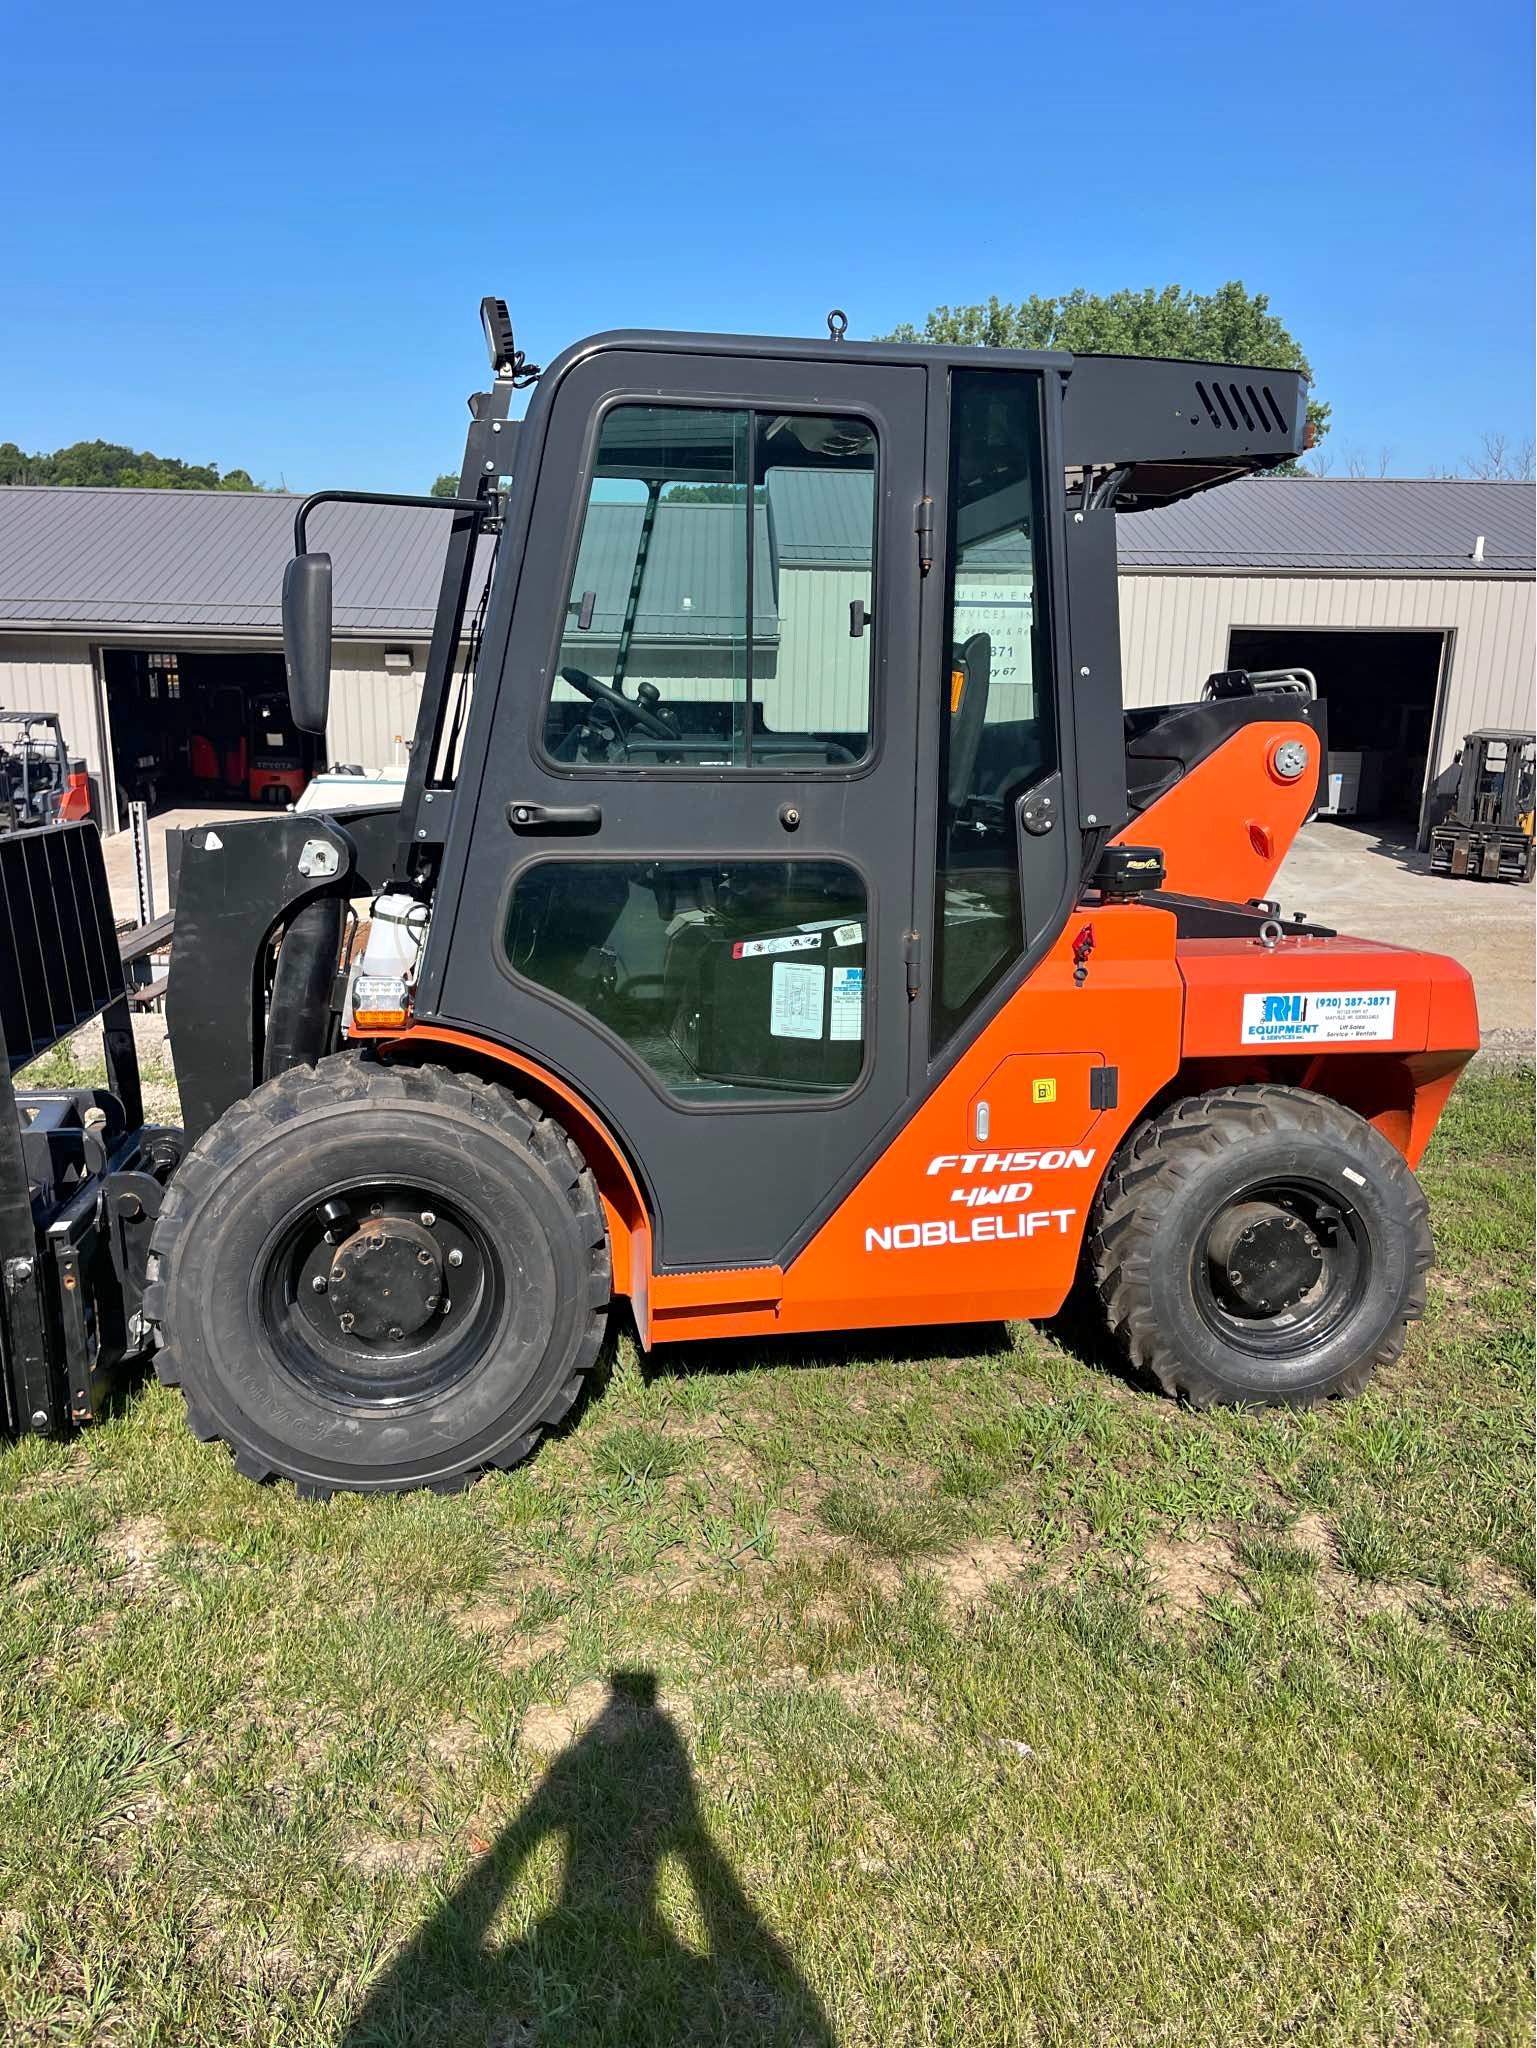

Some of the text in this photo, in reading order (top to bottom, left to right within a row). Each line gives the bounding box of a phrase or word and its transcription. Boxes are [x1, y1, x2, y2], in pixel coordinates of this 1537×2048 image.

[1002, 667, 1017, 676] 67
[1265, 996, 1390, 1022] RH (920) 387-3871
[1248, 1024, 1319, 1035] EQUIPMENT
[950, 1183, 1033, 1207] 4WD
[865, 1209, 1076, 1252] NOBLELIFT
